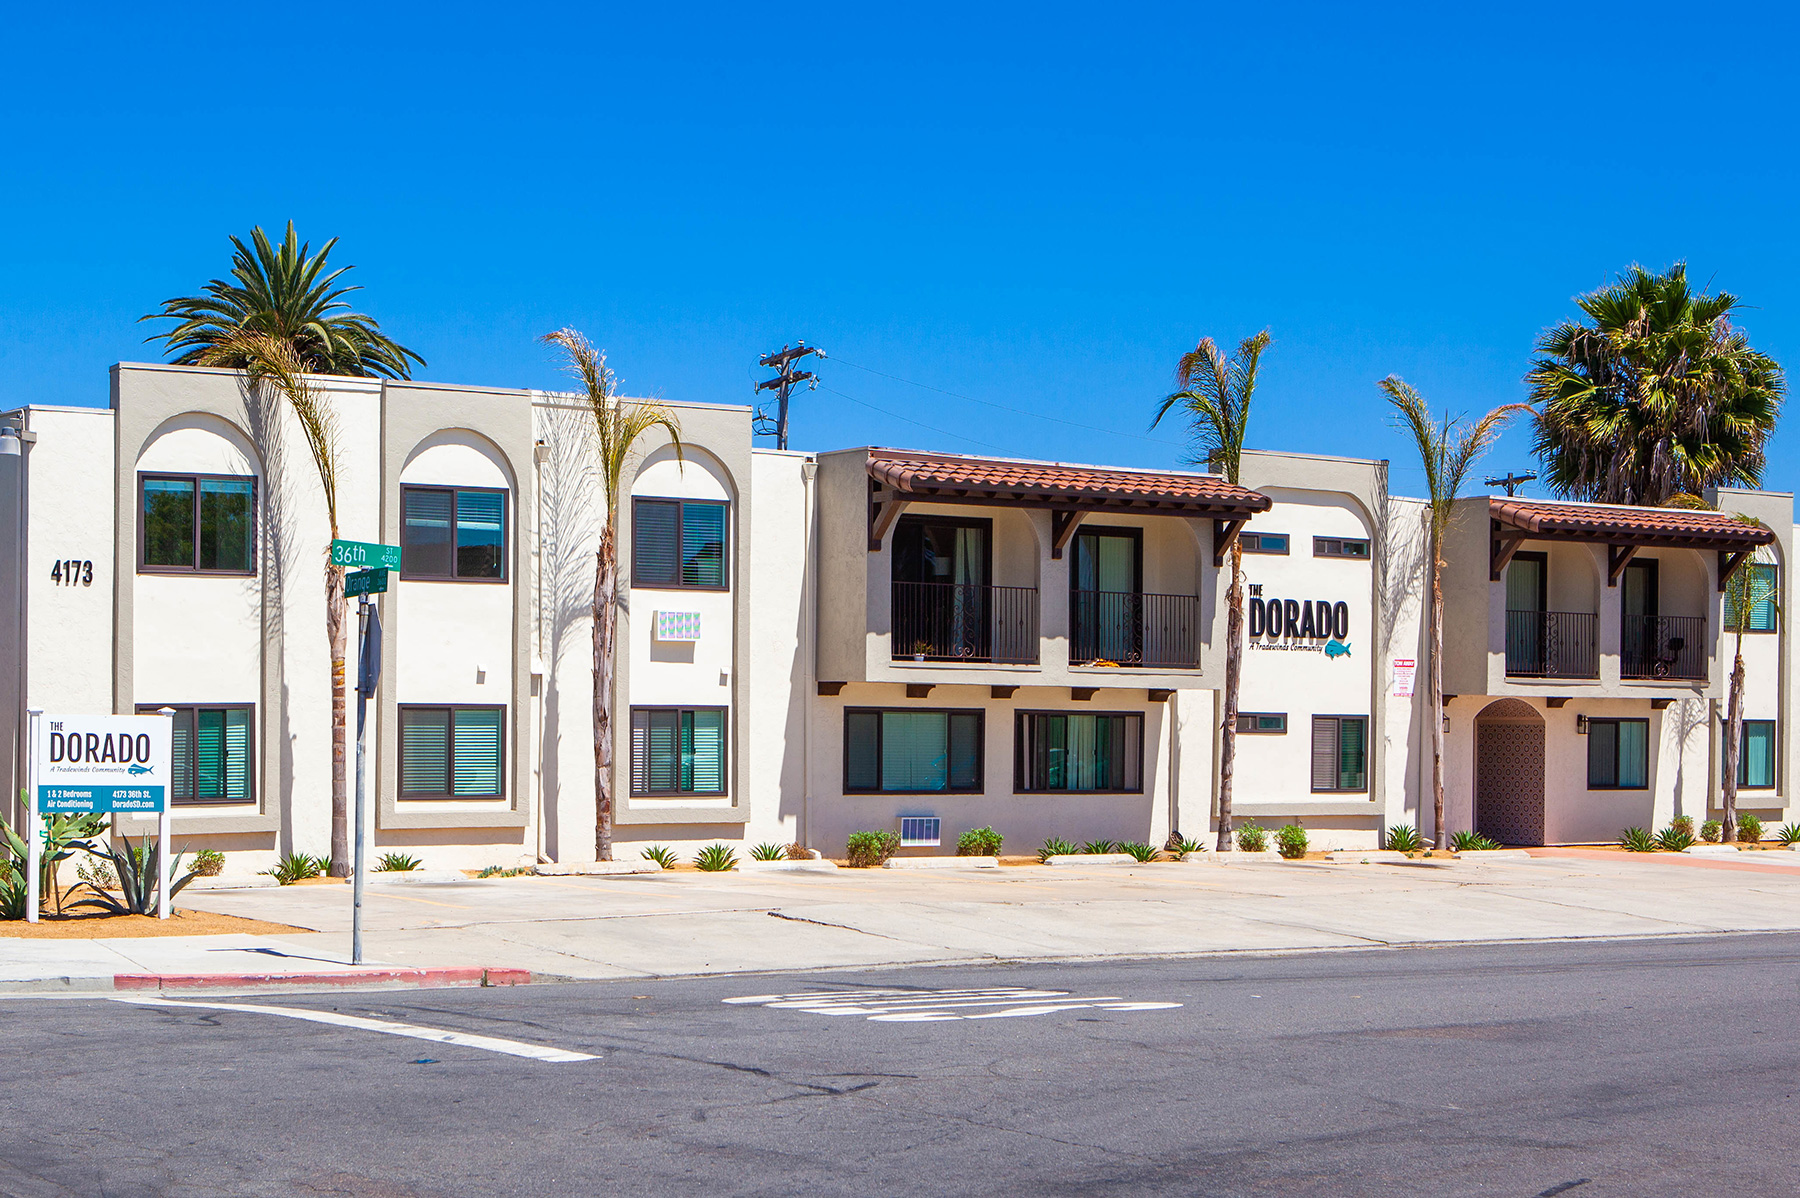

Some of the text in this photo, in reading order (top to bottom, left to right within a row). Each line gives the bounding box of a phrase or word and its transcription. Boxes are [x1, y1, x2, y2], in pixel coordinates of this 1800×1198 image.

[334, 545, 366, 564] 36th
[381, 555, 398, 563] 4200
[50, 559, 93, 585] 4173
[346, 575, 370, 592] Orange
[1248, 584, 1263, 597] THE
[1248, 598, 1349, 640] DORADO
[1249, 642, 1323, 654] A Tradewinds Community
[50, 721, 64, 731] THE
[50, 732, 151, 764] DORADO
[56, 765, 91, 773] Tradewinds
[91, 766, 126, 775] Community
[47, 789, 92, 799] 1 & 2 Bedrooms
[112, 790, 152, 798] 4173 36th St.
[47, 799, 94, 809] Air Conditioning
[112, 800, 155, 809] DoradoSD.com
